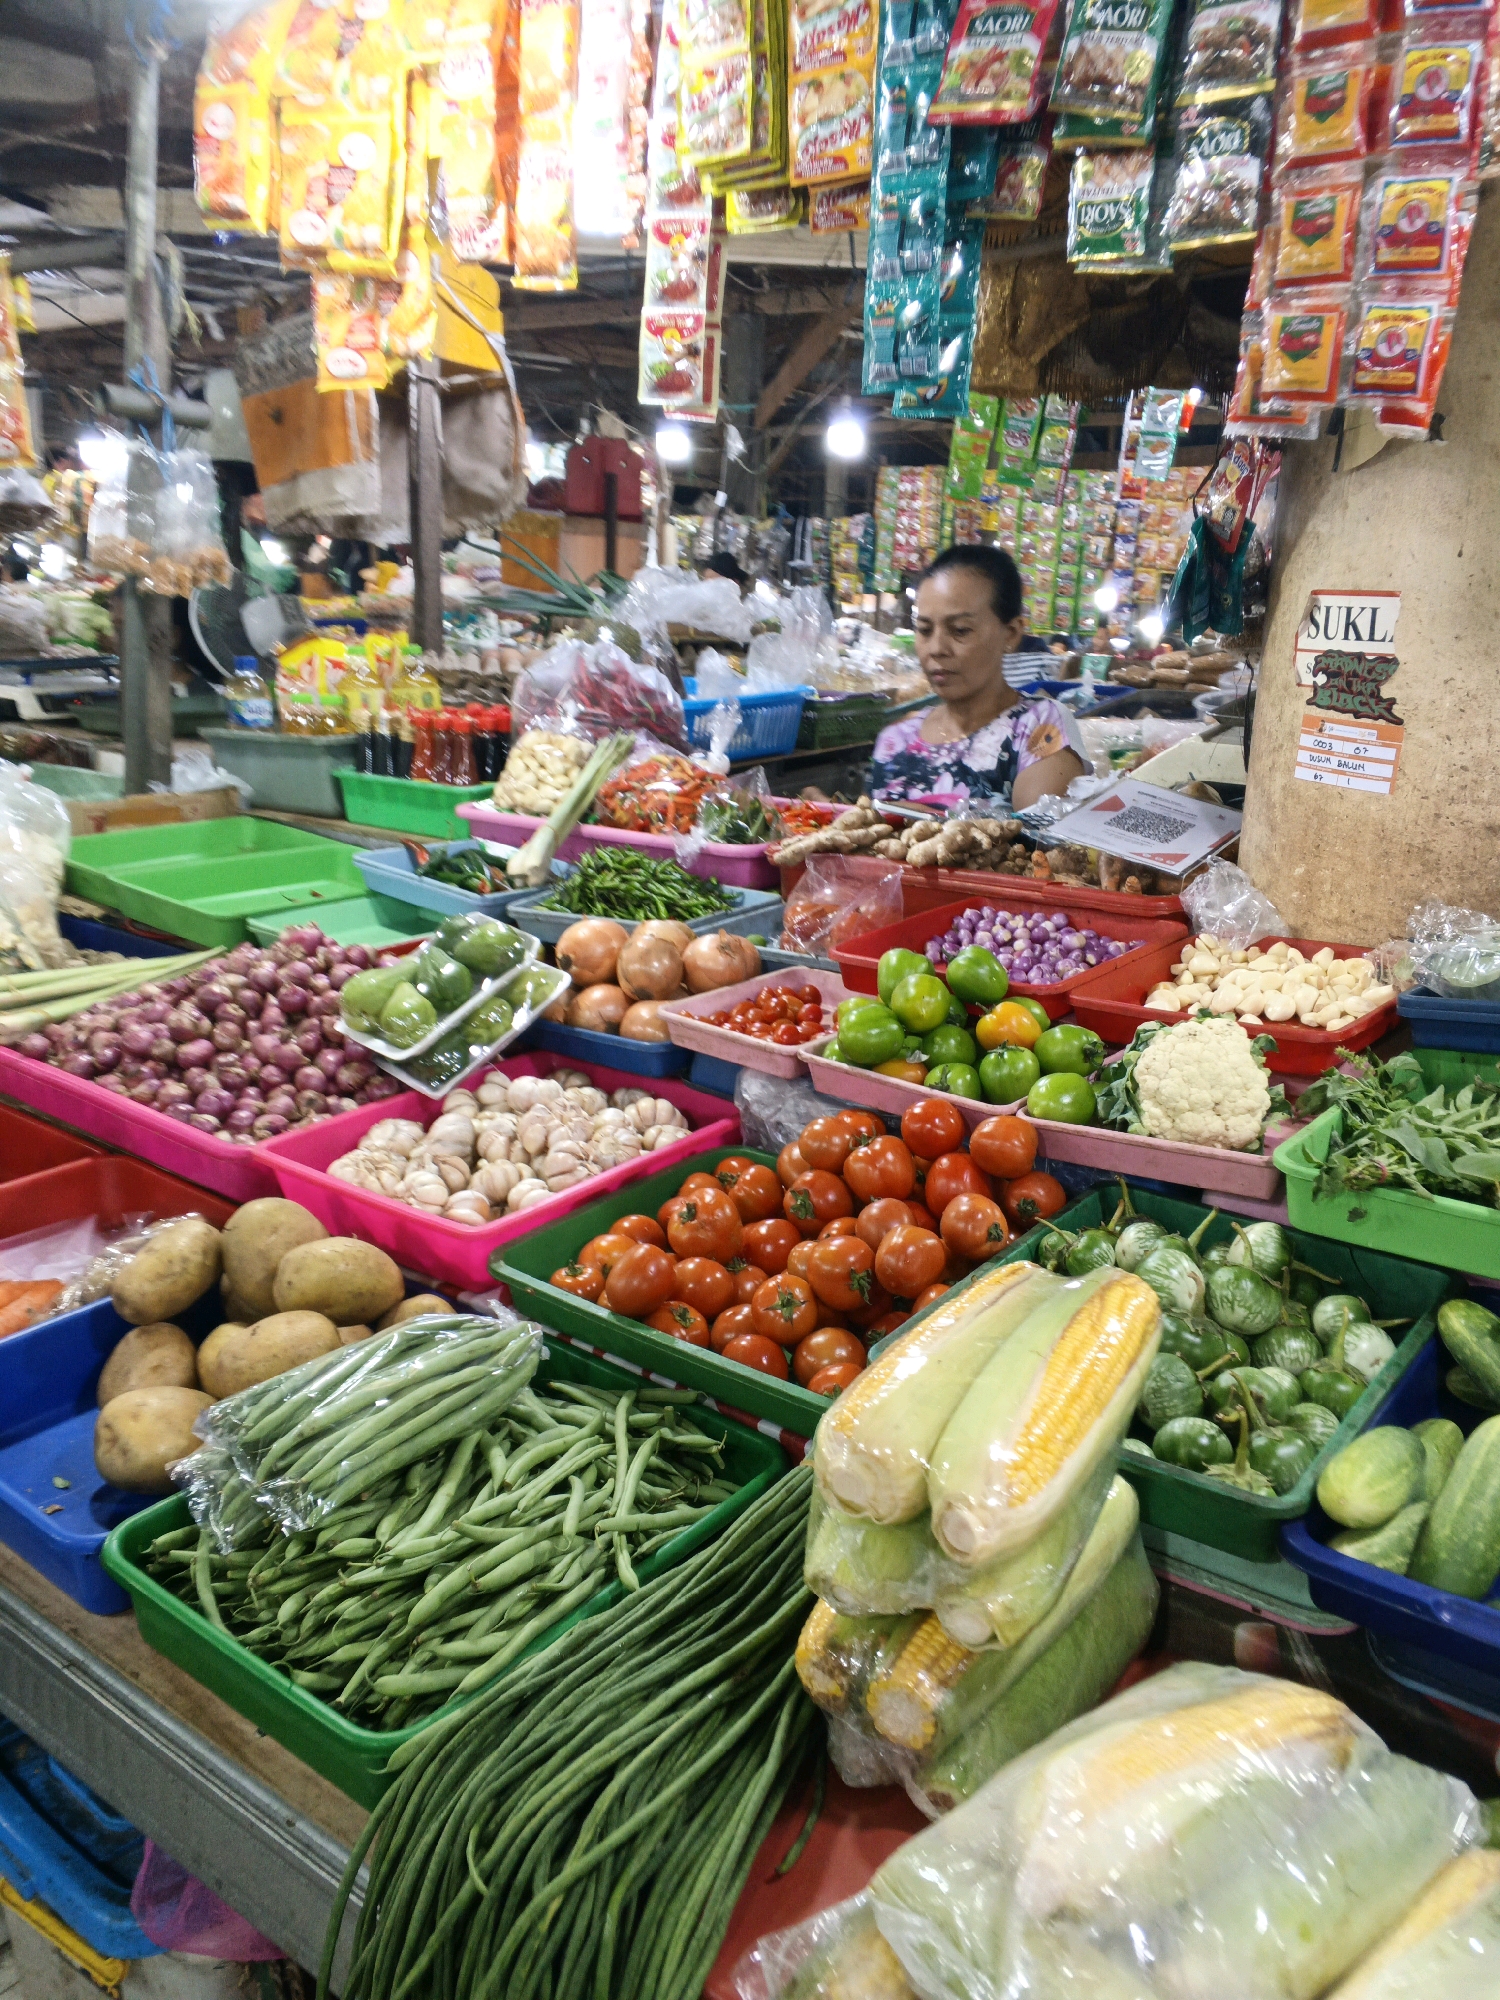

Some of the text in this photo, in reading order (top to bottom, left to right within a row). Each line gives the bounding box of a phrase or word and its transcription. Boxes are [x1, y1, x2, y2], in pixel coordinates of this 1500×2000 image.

[972, 14, 1031, 35] SAORI
[1088, 4, 1147, 28] SAORI
[1080, 201, 1132, 224] SAORI
[1307, 604, 1394, 642] SUKL
[1313, 738, 1334, 751] 0003
